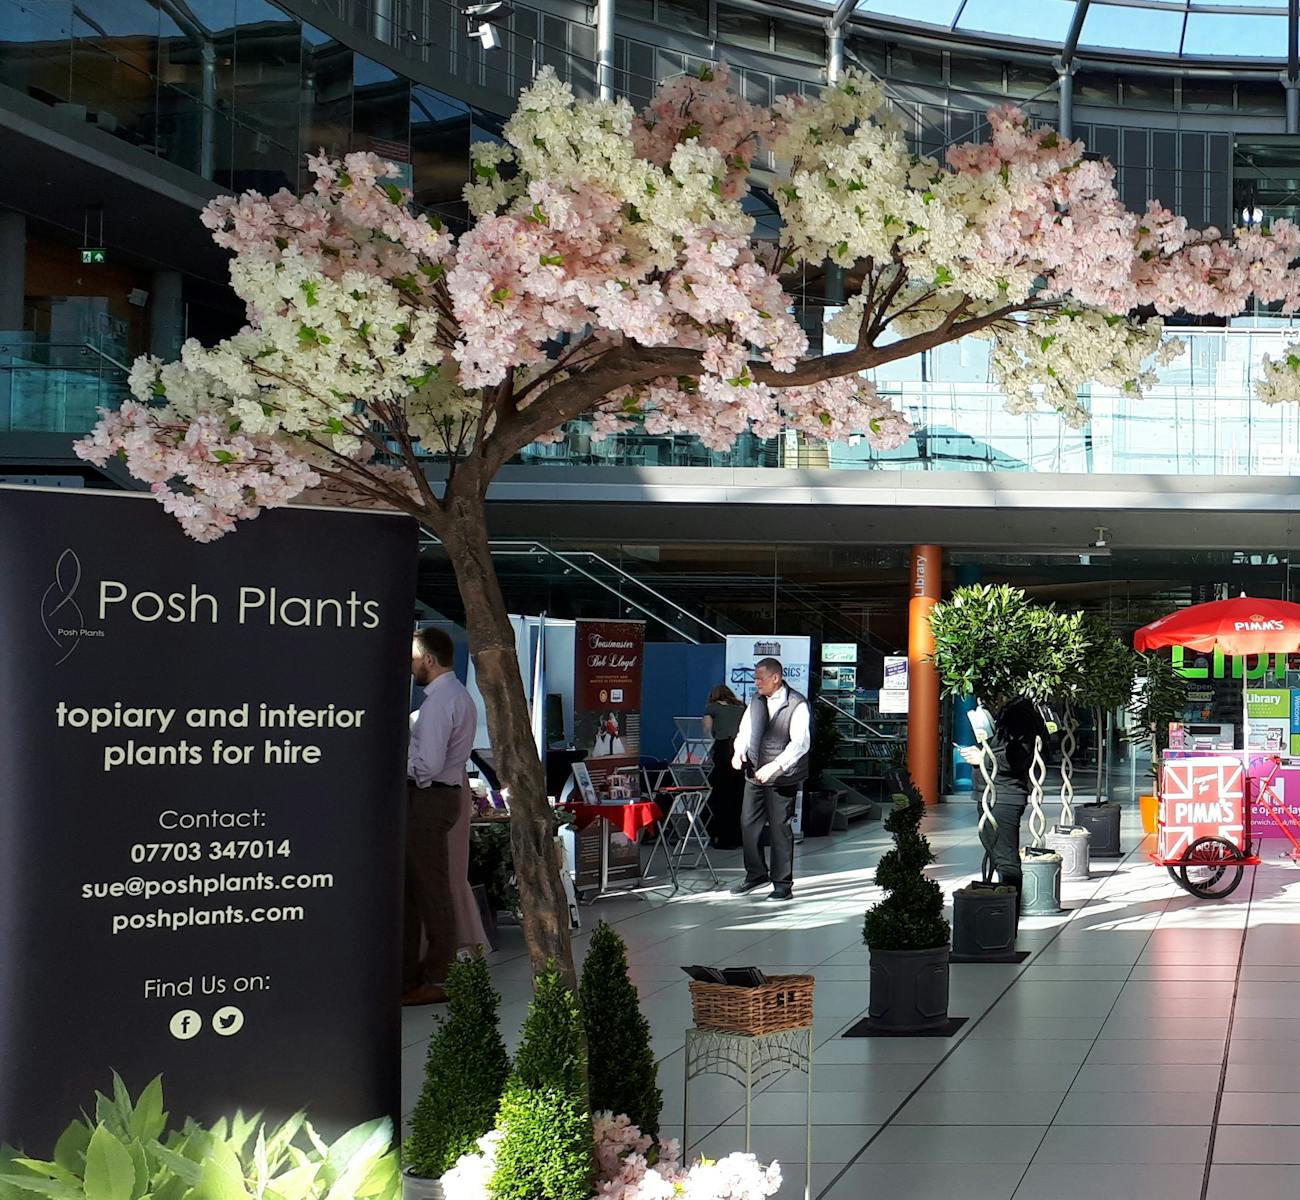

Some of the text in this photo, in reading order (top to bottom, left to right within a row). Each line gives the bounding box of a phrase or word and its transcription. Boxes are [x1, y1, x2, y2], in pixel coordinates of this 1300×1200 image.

[914, 555, 928, 597] Library
[99, 580, 381, 629] Posh Plants
[58, 628, 105, 637] Posh Plants
[1234, 619, 1285, 631] PIMM'S
[588, 633, 633, 649] Toastmaster
[587, 653, 638, 671] Bob Lloyd
[1247, 693, 1281, 705] Library
[56, 701, 366, 733] topiary and interior
[104, 739, 322, 772] plants for hire
[158, 808, 267, 831] Contact:
[1175, 799, 1234, 824] PIMM'S
[130, 839, 291, 864] 07703 347014
[81, 870, 335, 899] sue@poshplants.com
[112, 904, 304, 934] poshplants.com
[144, 974, 271, 999] Find Us on:
